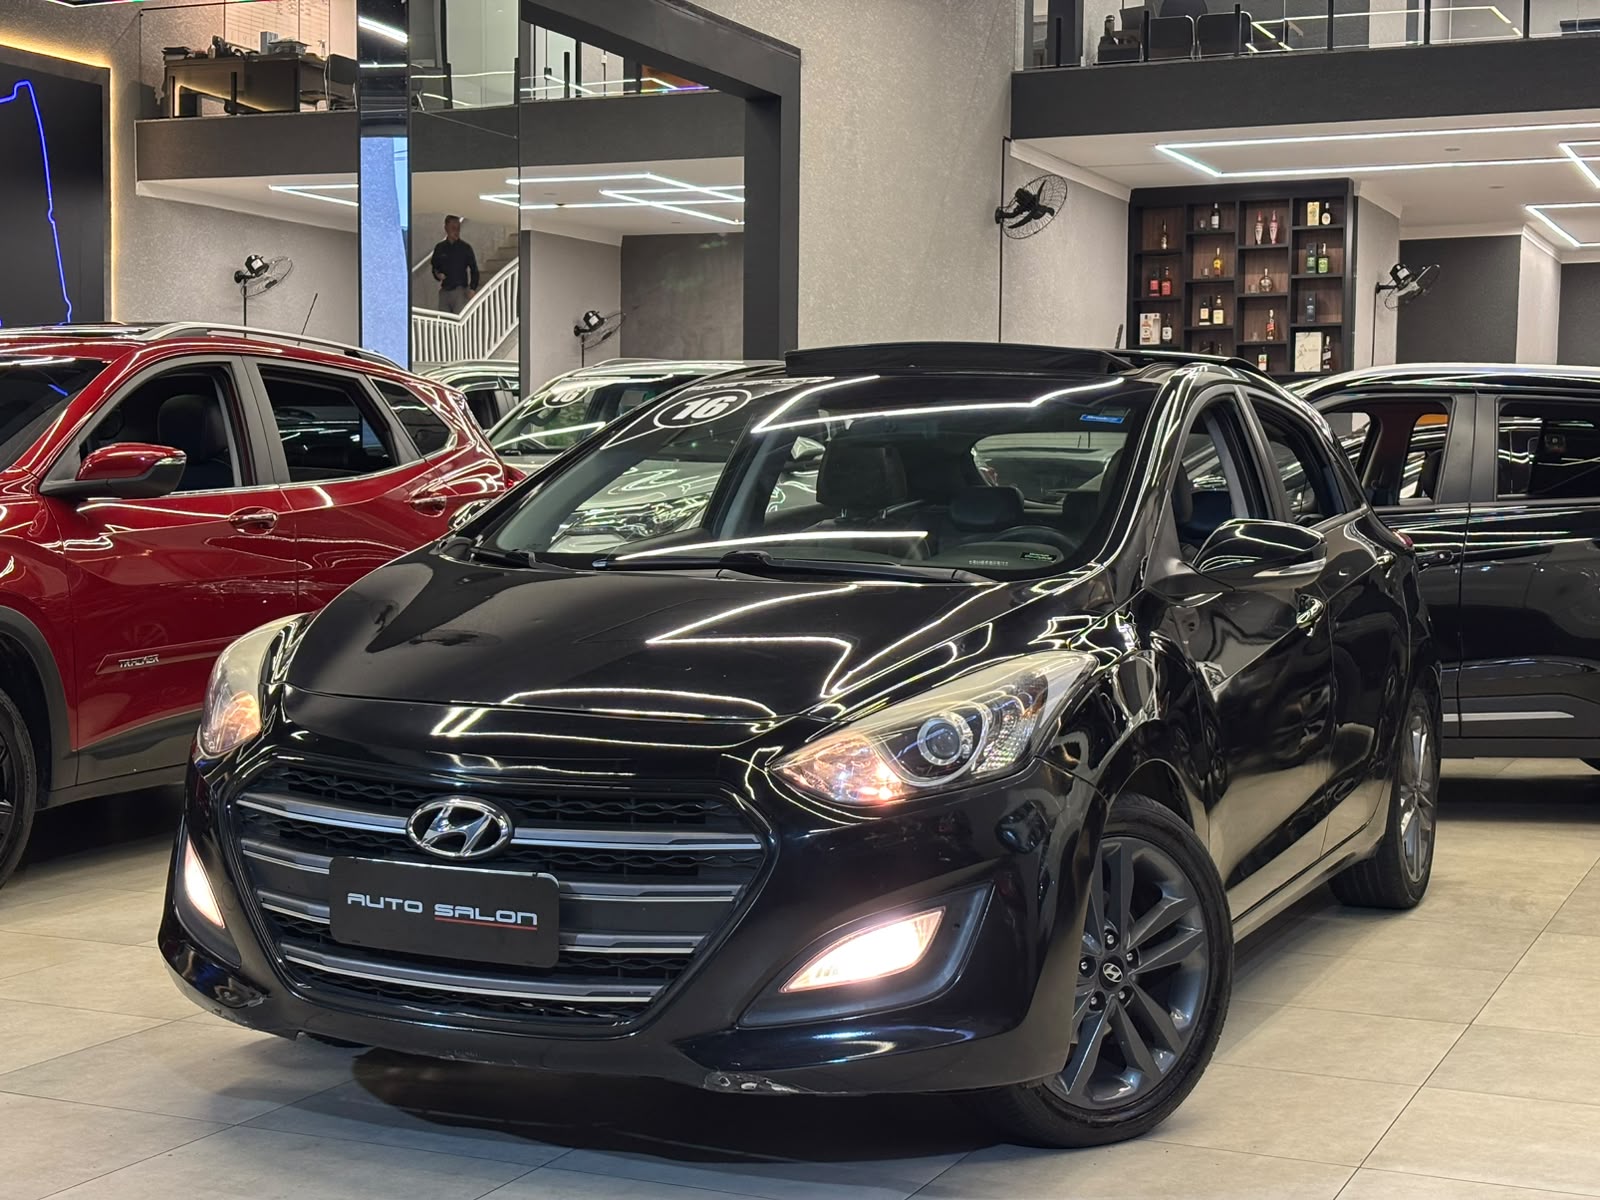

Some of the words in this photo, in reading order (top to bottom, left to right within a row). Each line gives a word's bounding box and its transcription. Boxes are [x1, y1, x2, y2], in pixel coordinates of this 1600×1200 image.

[551, 386, 585, 403] 16
[672, 395, 738, 420] 16
[118, 653, 160, 668] TRACKER
[347, 892, 423, 914] AUTO
[434, 903, 538, 926] SALON
